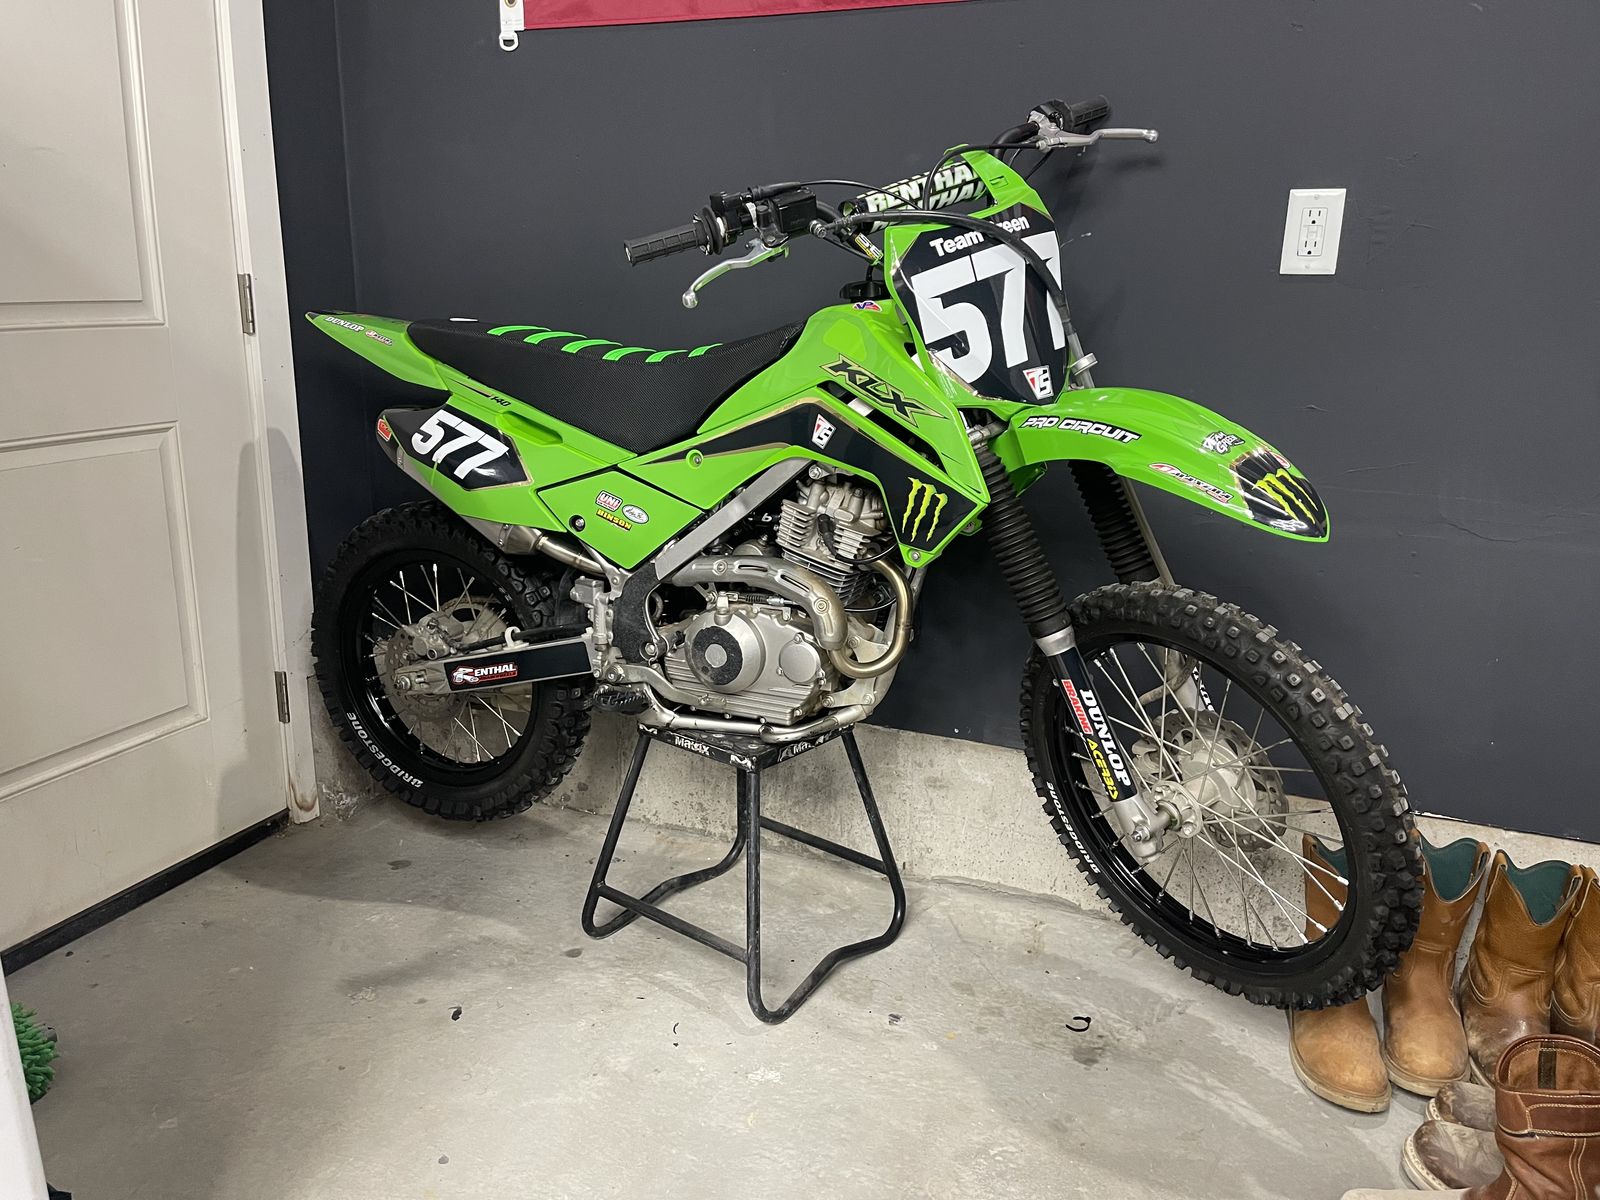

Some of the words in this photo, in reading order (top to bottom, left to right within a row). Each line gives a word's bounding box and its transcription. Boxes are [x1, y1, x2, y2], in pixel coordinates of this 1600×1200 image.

[929, 231, 985, 257] Team
[989, 215, 1030, 234] een
[325, 316, 365, 332] DUNLOP
[911, 231, 1066, 384] 577
[820, 353, 944, 428] KLX
[411, 409, 510, 480] 577
[1022, 416, 1059, 428] PRO
[1059, 419, 1141, 443] CIRCUIT
[599, 493, 621, 509] UNI
[1062, 679, 1093, 735] BRAKING
[1080, 689, 1131, 786] DUNLOP
[346, 712, 424, 788] BRIDGESTONE
[1046, 781, 1101, 873] BRIDGESTONE
